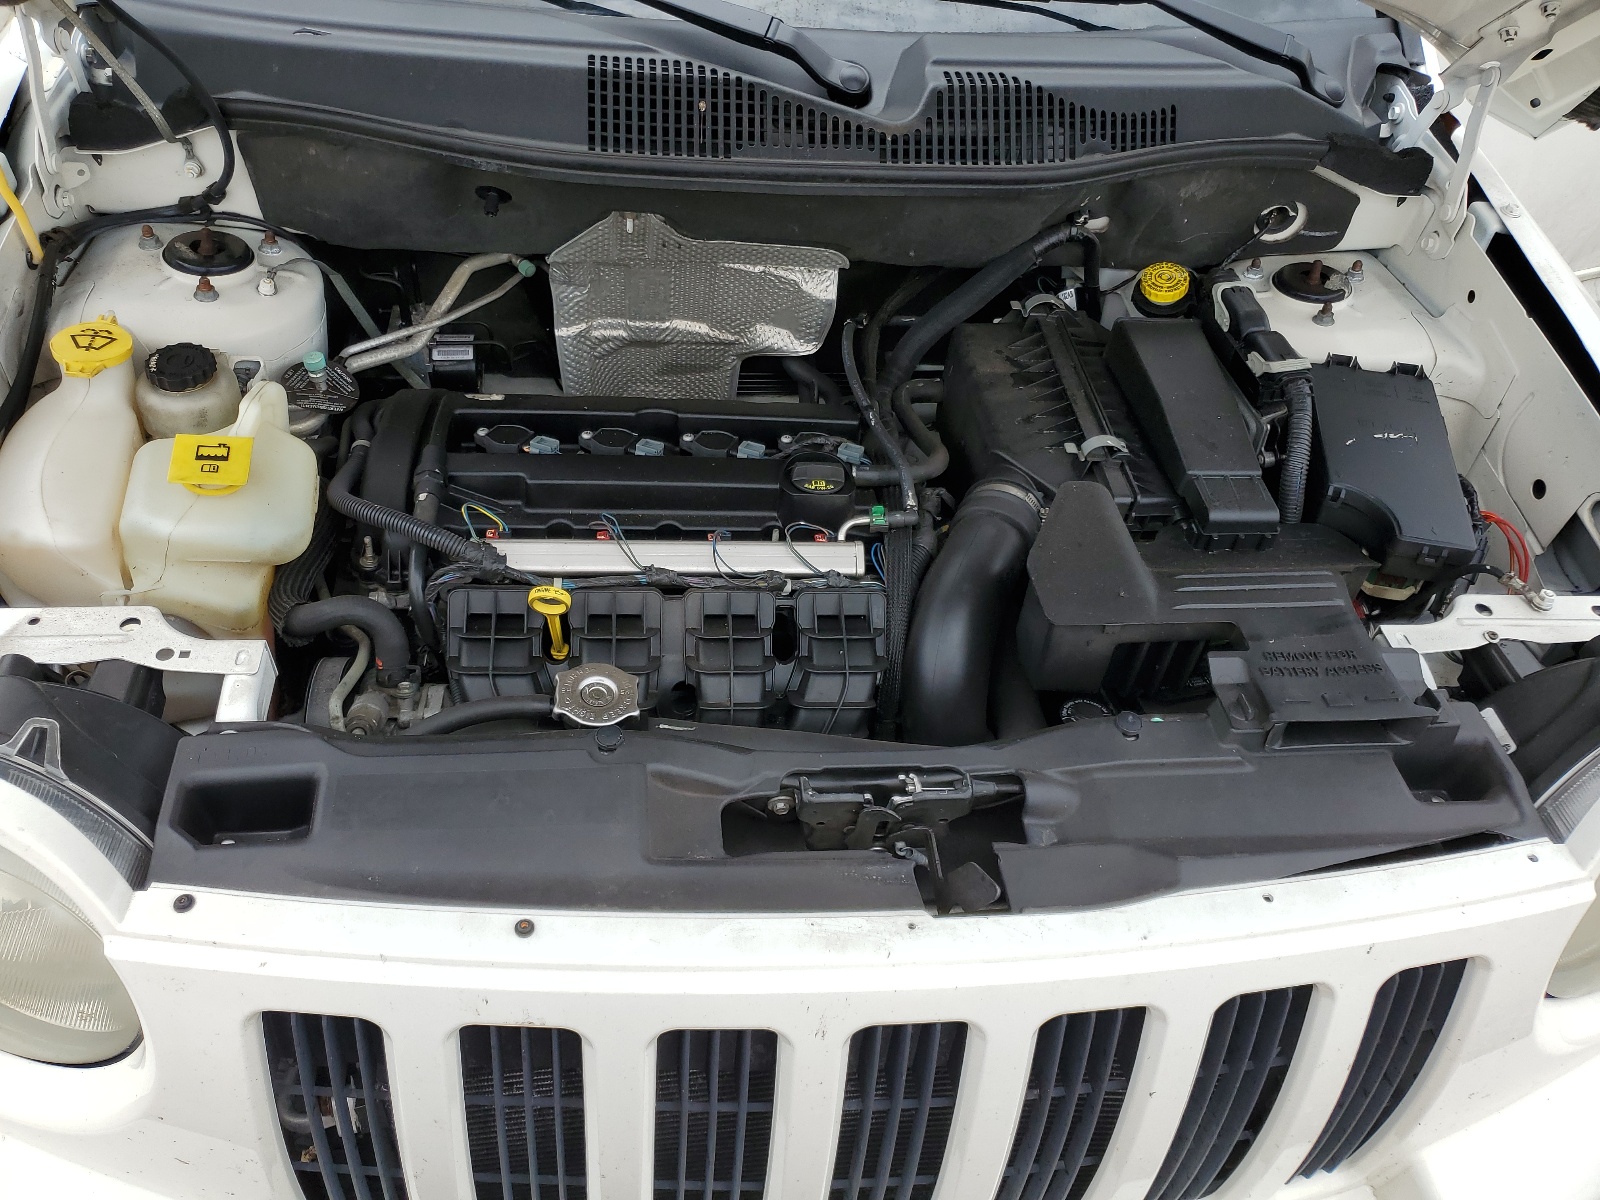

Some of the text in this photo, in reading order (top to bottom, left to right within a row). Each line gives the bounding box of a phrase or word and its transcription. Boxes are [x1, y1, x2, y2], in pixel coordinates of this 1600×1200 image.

[1262, 649, 1358, 662] REMOVE FOR
[1259, 663, 1383, 677] BATTERY ACCESS
